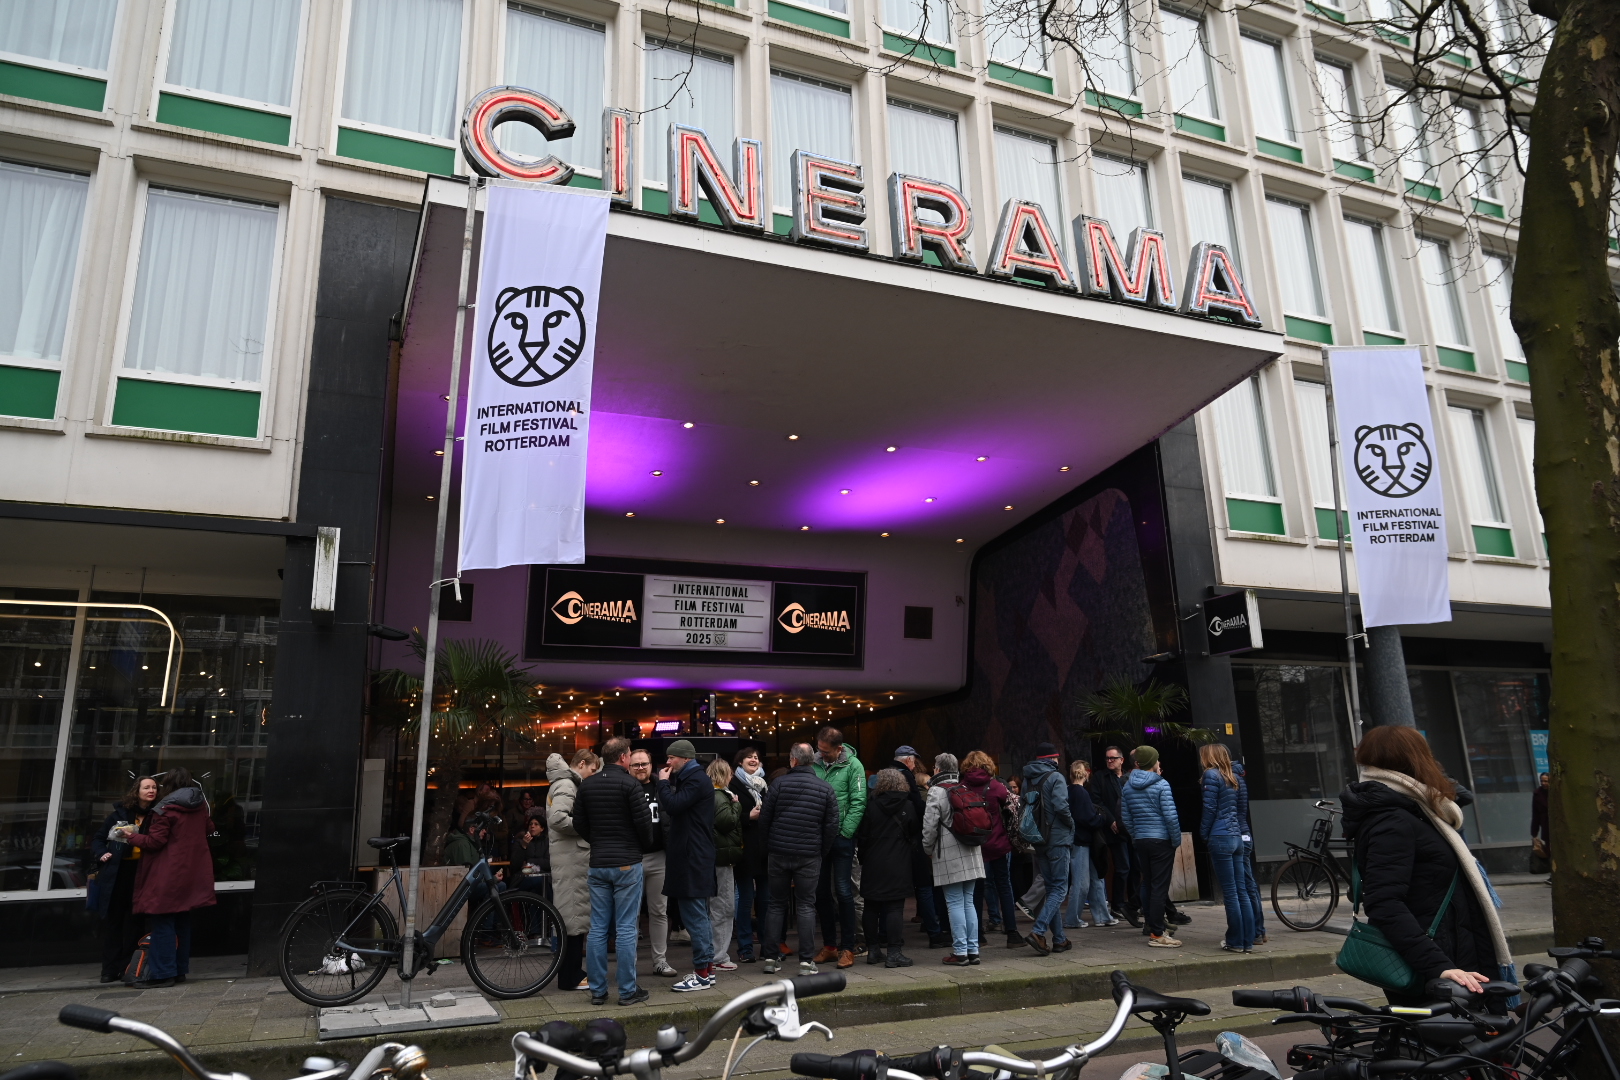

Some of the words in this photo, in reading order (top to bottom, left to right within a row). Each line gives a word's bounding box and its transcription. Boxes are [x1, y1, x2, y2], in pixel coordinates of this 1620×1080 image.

[460, 84, 1262, 328] CINERAMA
[477, 400, 584, 419] INTERNATIONAL
[480, 421, 511, 436] FILM
[513, 417, 578, 432] FESTIVAL
[484, 434, 570, 452] ROTTERDAM
[1357, 507, 1442, 520] INTERNATIONAL
[1362, 522, 1389, 532] FILM
[1391, 520, 1439, 530] FESTIVAL
[1369, 533, 1435, 544] ROTTERDAM
[673, 583, 749, 598] INTERNATIONAL
[567, 599, 637, 620] CINERAMA
[674, 600, 697, 611] FILM
[701, 601, 745, 614] FESTIVAL
[680, 616, 738, 629] ROTTERDAM
[791, 610, 851, 630] CINERAMA
[686, 633, 712, 645] 2025
